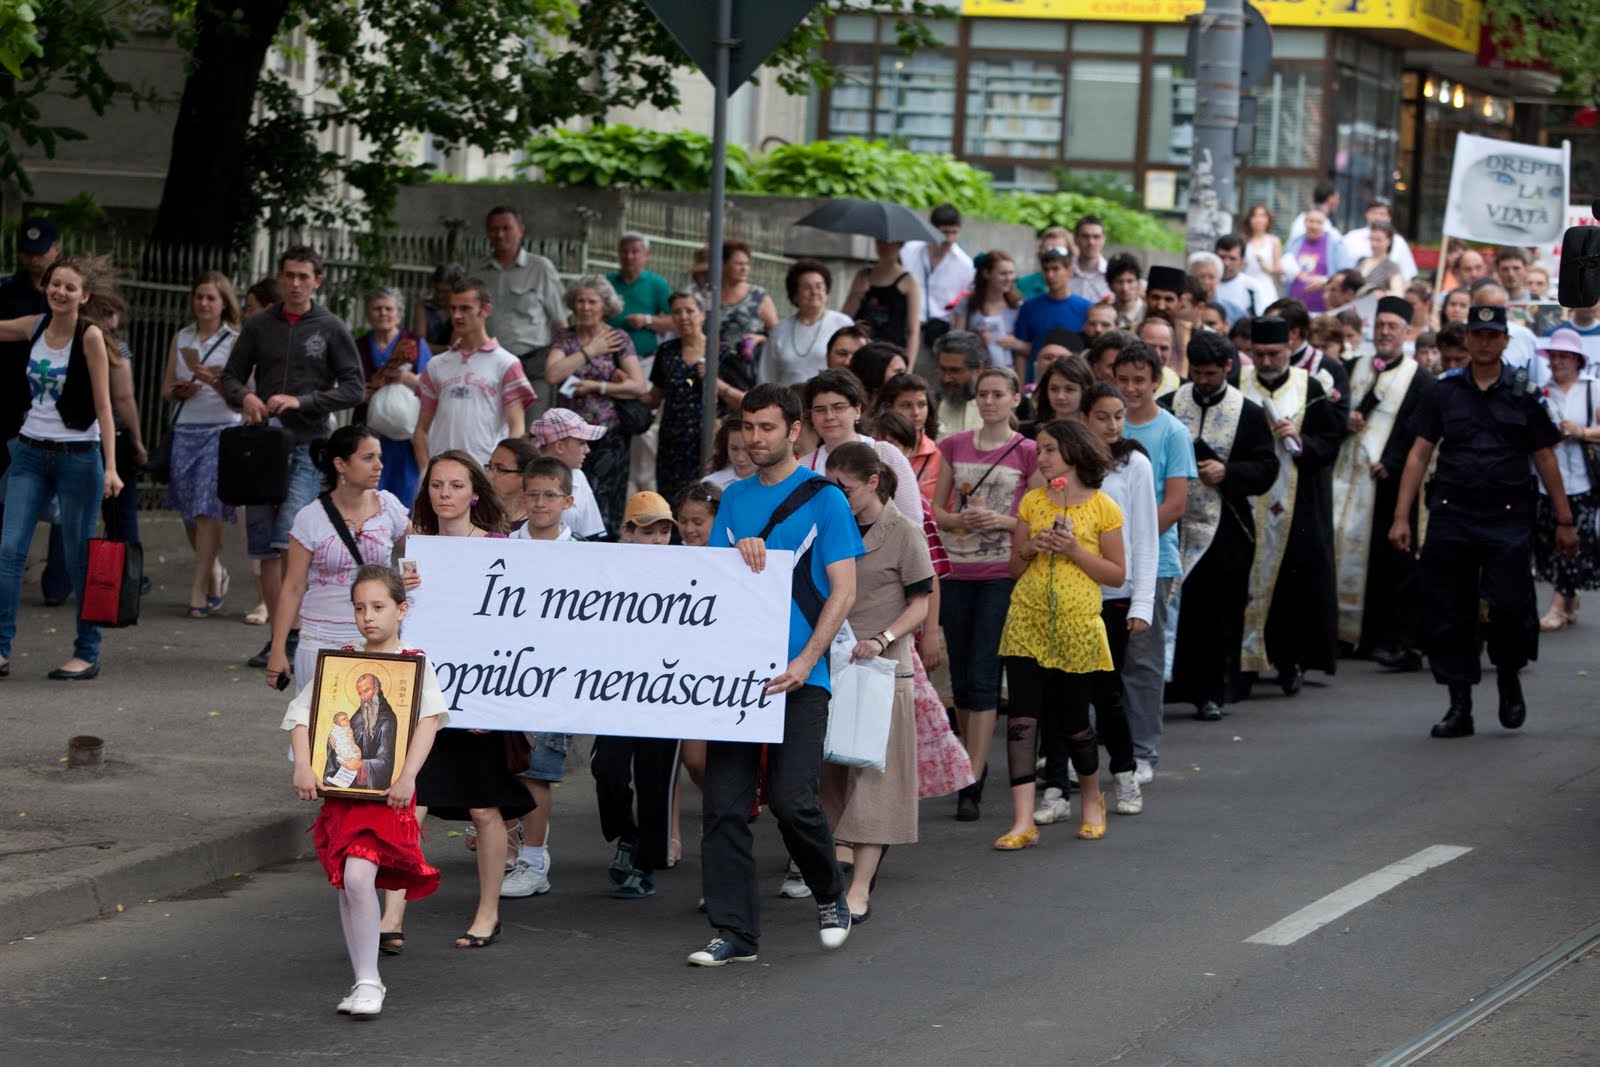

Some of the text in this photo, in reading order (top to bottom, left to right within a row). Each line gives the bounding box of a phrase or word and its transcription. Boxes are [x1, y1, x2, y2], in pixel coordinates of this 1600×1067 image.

[1517, 183, 1543, 199] LA
[472, 558, 718, 627] În memoria
[431, 646, 567, 711] opiilor
[573, 658, 777, 725] nenăscuți
